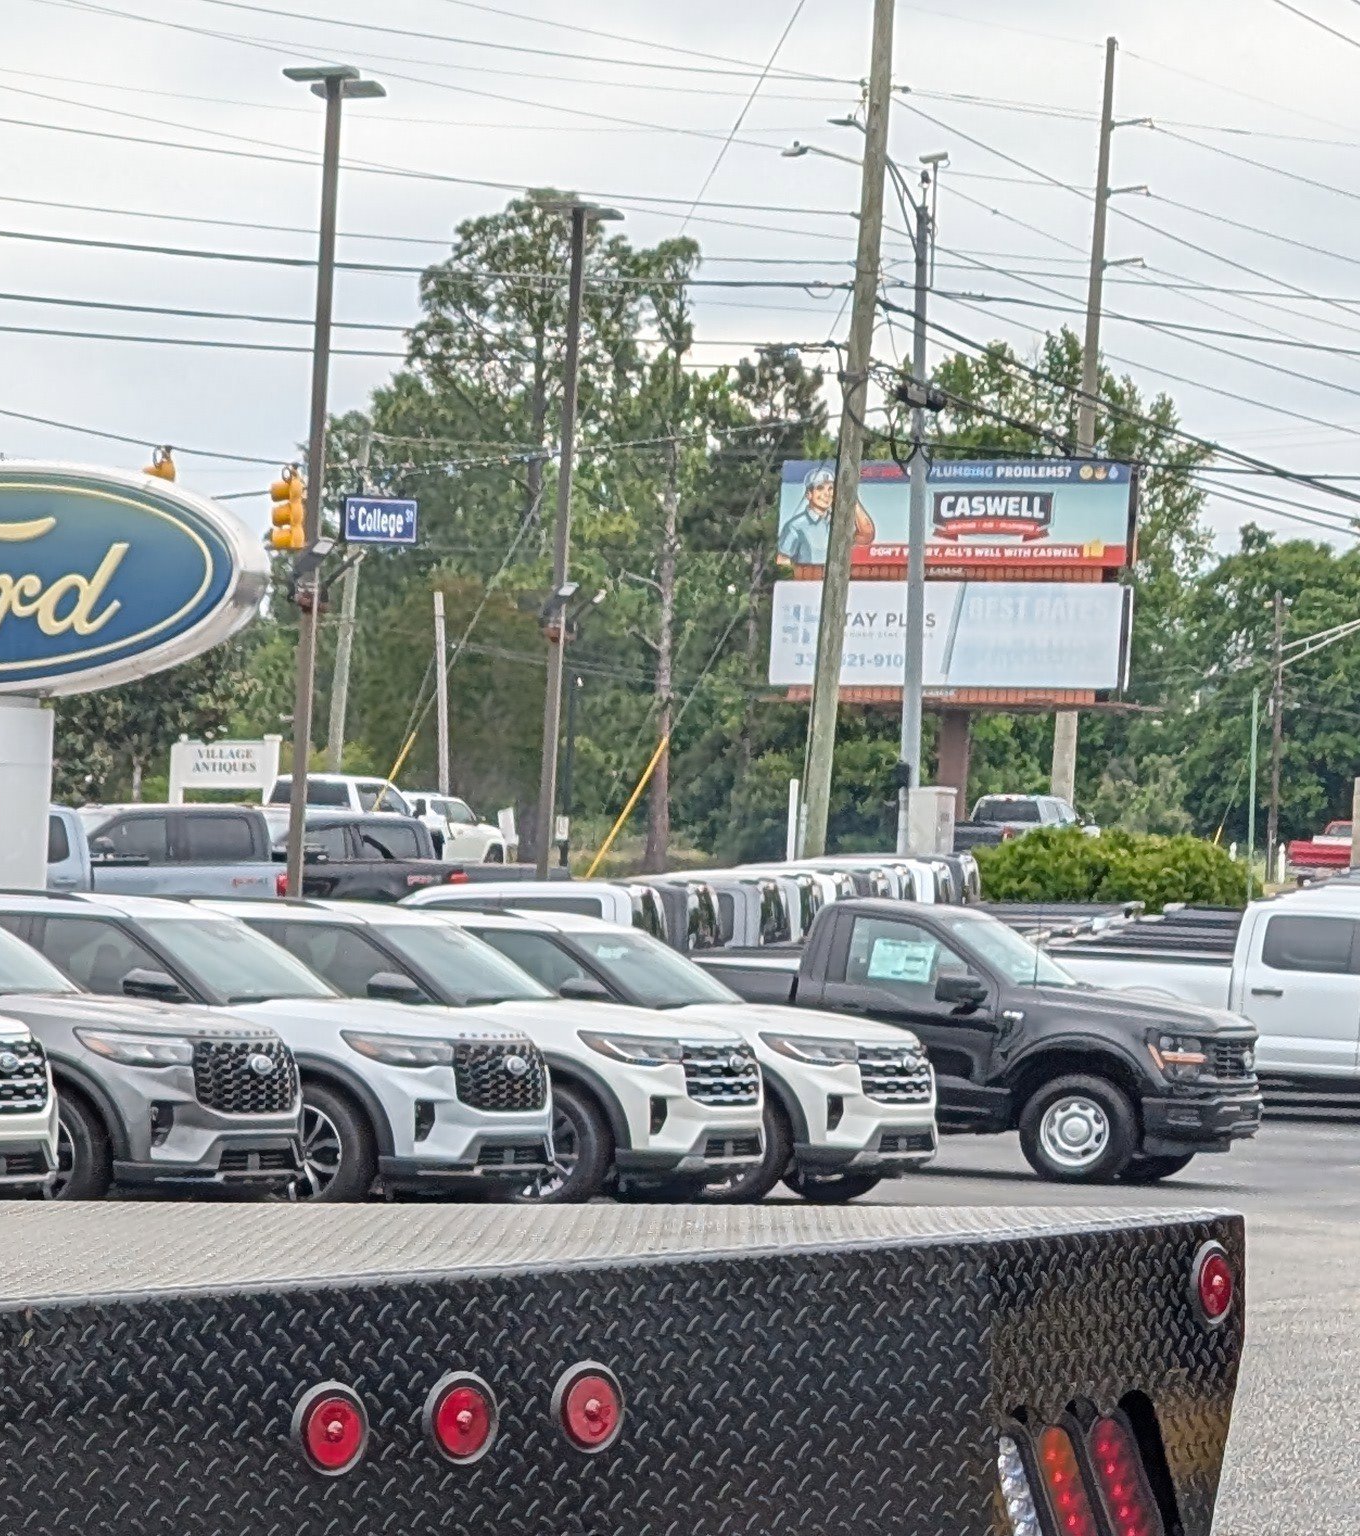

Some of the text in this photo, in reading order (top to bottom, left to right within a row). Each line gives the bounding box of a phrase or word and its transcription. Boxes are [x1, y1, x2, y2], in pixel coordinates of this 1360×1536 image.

[996, 466, 1072, 478] PROBLEMS?
[940, 496, 1045, 518] CASWELL
[349, 505, 356, 520] S
[358, 506, 404, 537] College
[869, 547, 899, 557] DON'T
[944, 547, 972, 557] ALL'S
[974, 547, 1002, 557] WELL
[1004, 547, 1030, 558] WITH
[1032, 547, 1080, 558] CASWELL
[885, 612, 936, 628] PLS
[197, 748, 254, 759] VILLAGE
[192, 761, 257, 774] ANTIQUES
